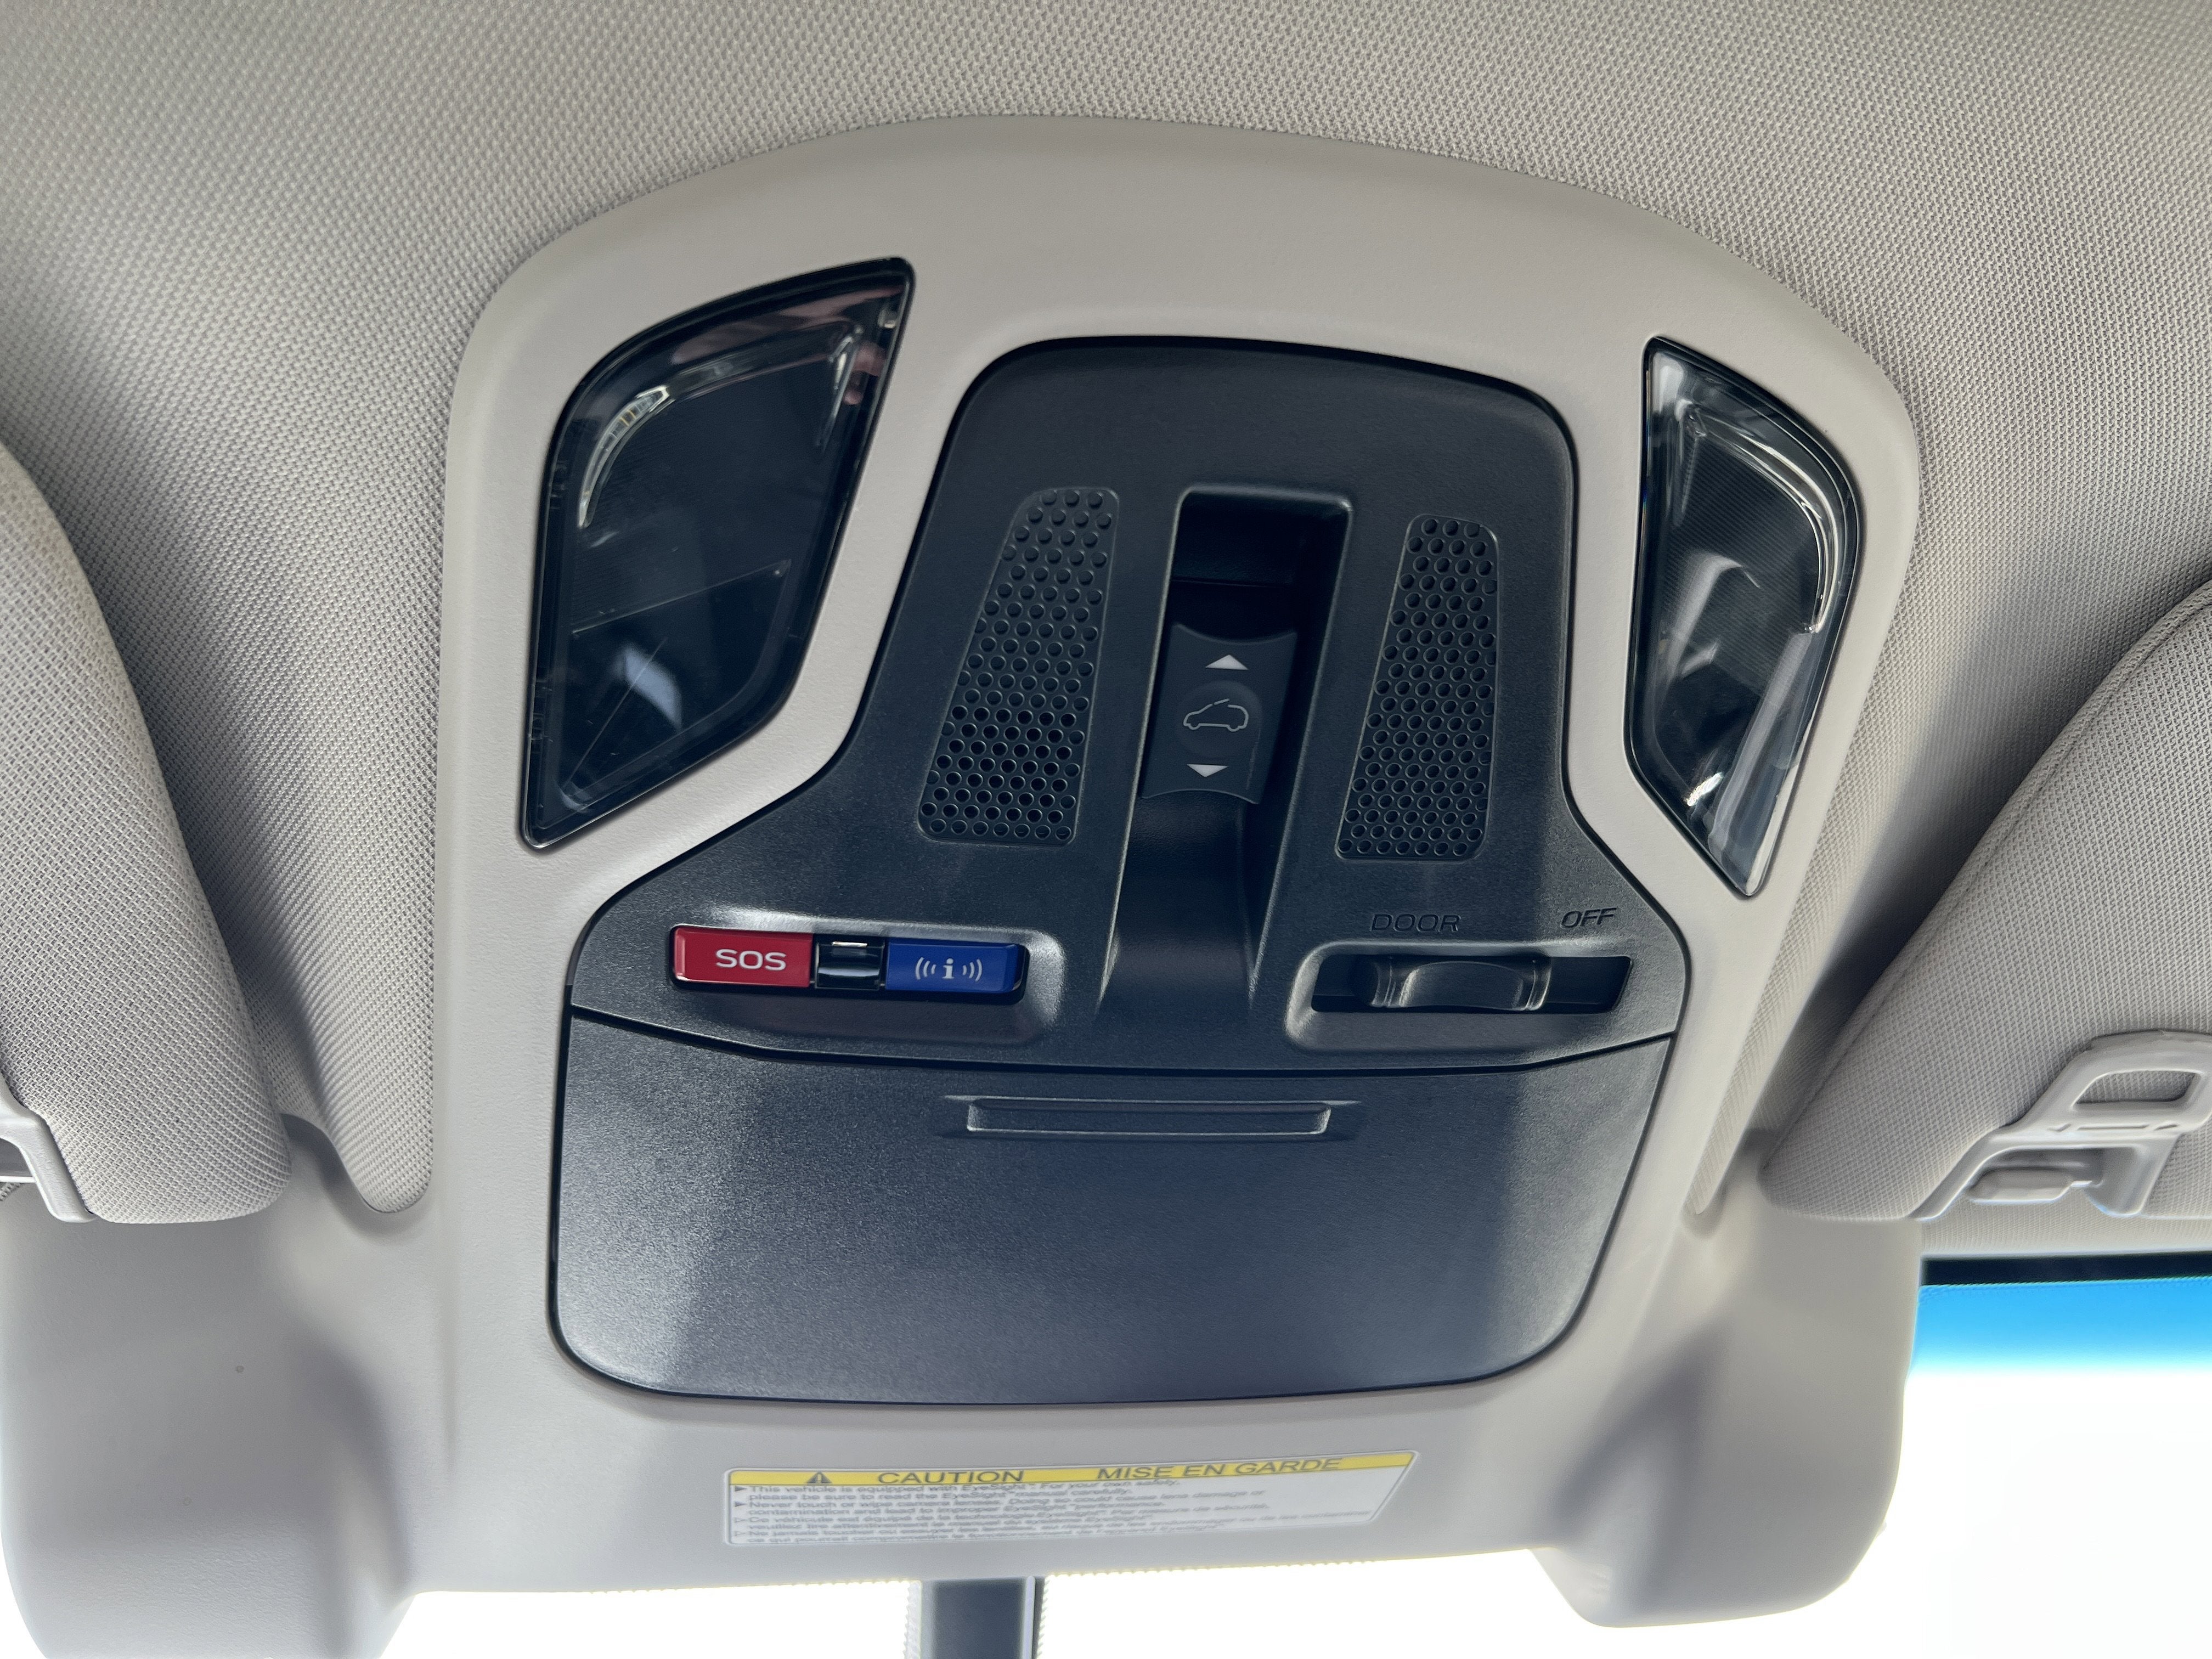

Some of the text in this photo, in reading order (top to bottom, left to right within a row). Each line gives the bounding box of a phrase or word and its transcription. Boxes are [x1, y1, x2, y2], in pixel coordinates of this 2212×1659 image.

[1372, 913, 1462, 932] DOOR
[1560, 907, 1617, 929] OFF
[715, 949, 787, 971] SOS
[878, 1471, 1024, 1483] CAUTION
[1097, 1458, 1343, 1479] MISE EN GARDE
